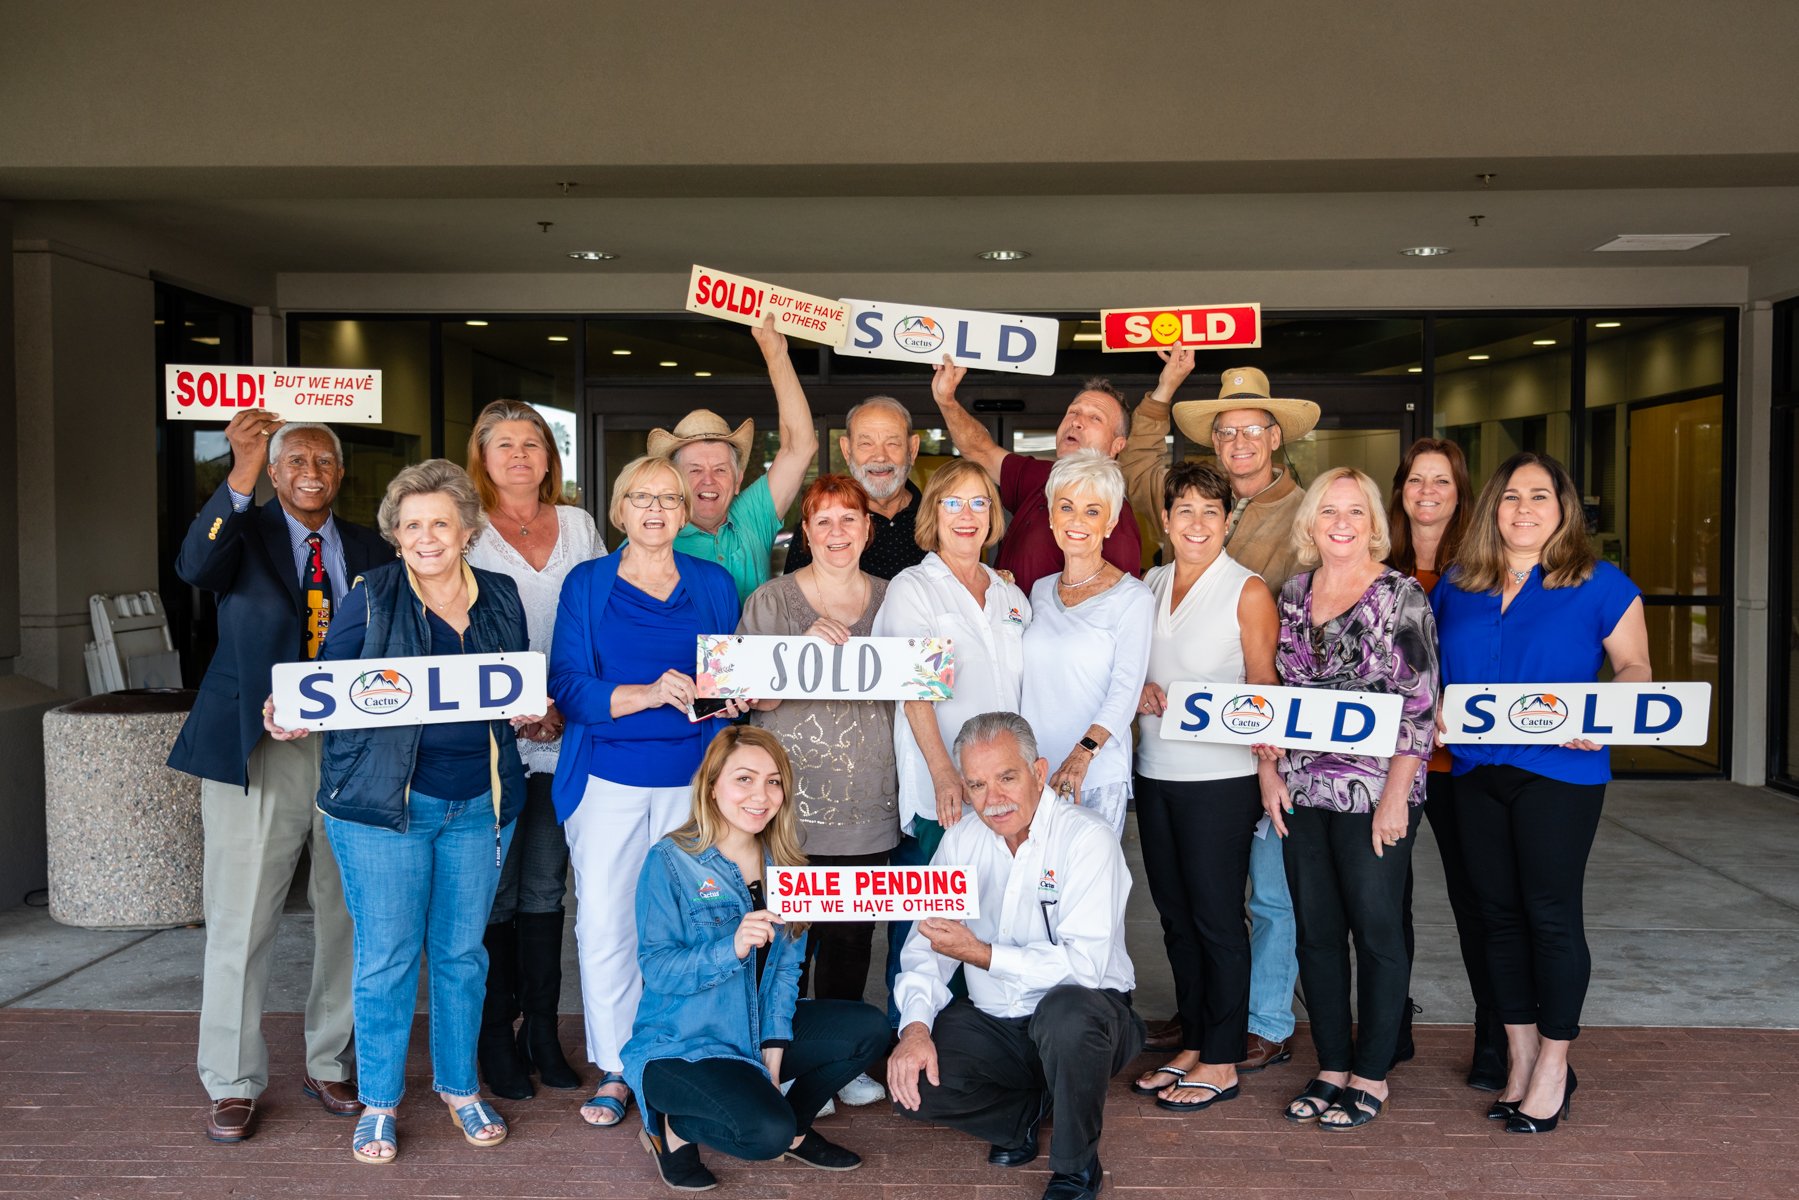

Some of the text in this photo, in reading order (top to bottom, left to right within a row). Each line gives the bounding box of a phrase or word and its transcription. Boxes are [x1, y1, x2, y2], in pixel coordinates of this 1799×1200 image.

[695, 275, 764, 318] SOLD!
[769, 293, 844, 321] BUT WE HAVE
[782, 311, 827, 332] OTHERS
[904, 337, 932, 347] Cactus
[176, 371, 265, 407] SOLD!
[274, 376, 374, 390] BUT WE HAVE
[294, 393, 354, 406] OTHERS
[770, 642, 882, 693] SOLD
[364, 697, 399, 707] Cactus
[1231, 718, 1260, 727] Cactus
[1521, 717, 1554, 726] Cactus
[778, 870, 966, 896] SALE PENDING
[782, 898, 965, 913] BUT WE HAVE OTHERS
